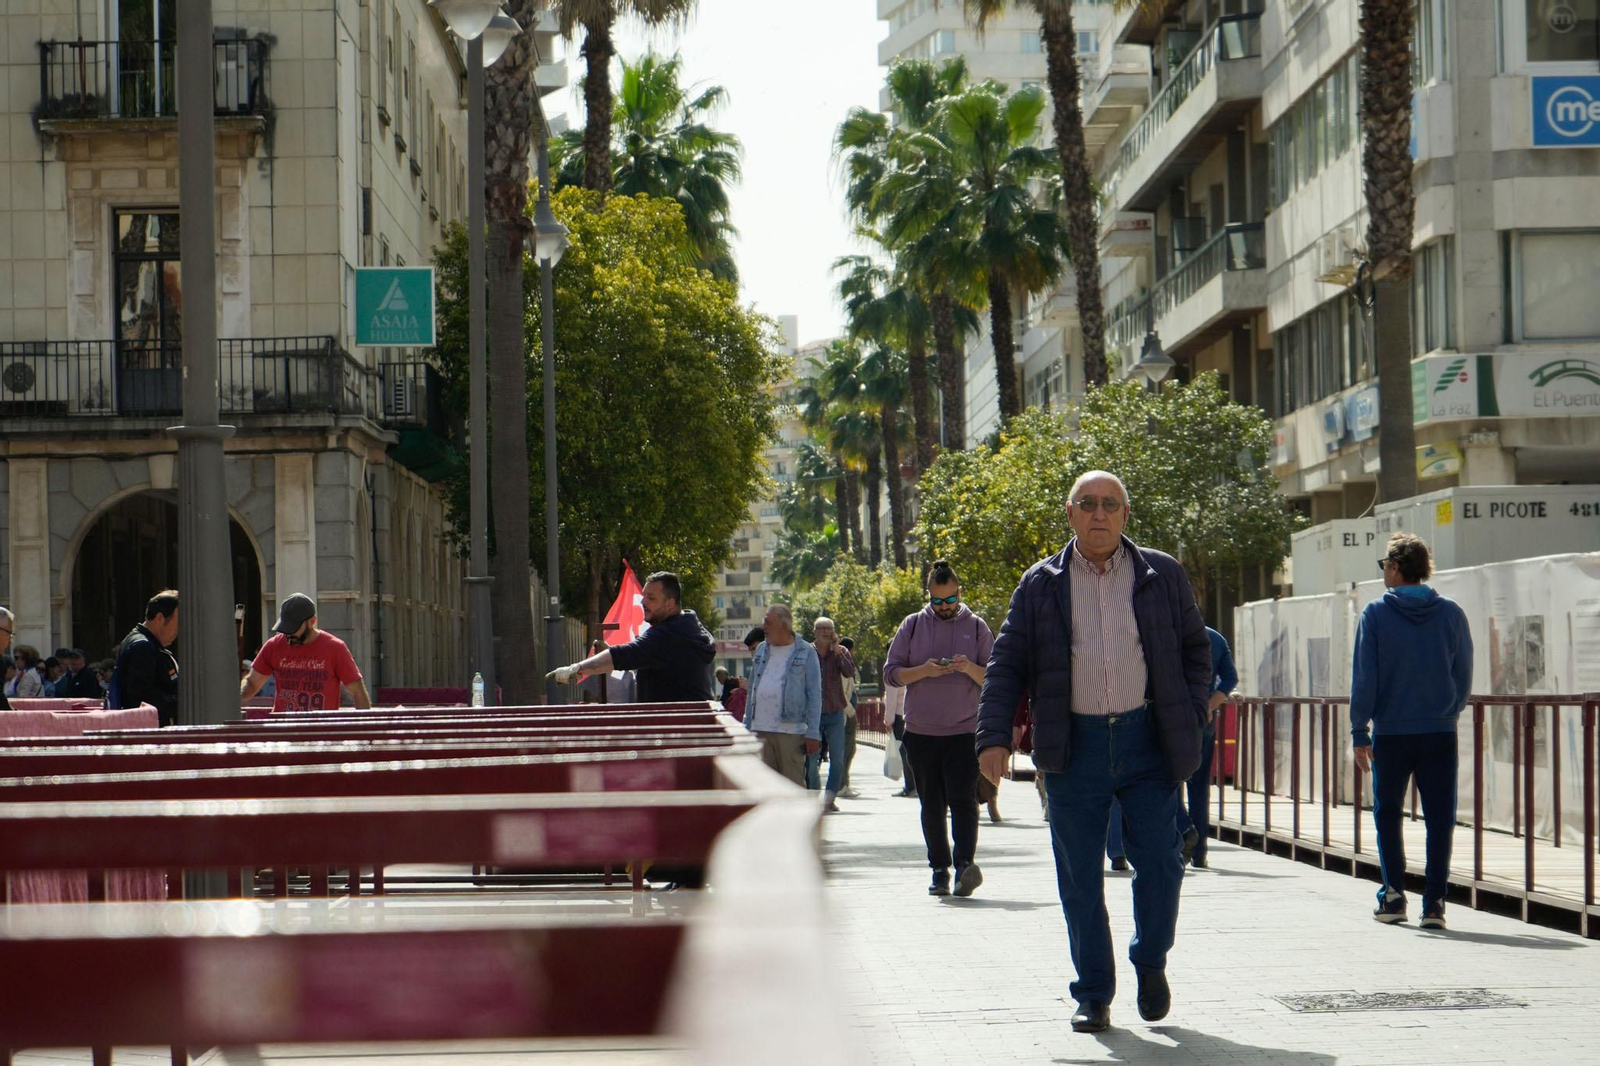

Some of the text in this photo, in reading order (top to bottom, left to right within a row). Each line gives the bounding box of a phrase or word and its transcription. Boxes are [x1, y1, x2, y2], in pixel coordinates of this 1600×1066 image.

[370, 315, 419, 329] ASAJA
[371, 330, 419, 341] HUELVA
[1533, 390, 1600, 408] El Puent
[1431, 405, 1446, 417] La
[1463, 503, 1481, 518] EL
[1490, 502, 1547, 518] PICOTE
[1343, 533, 1359, 547] EL
